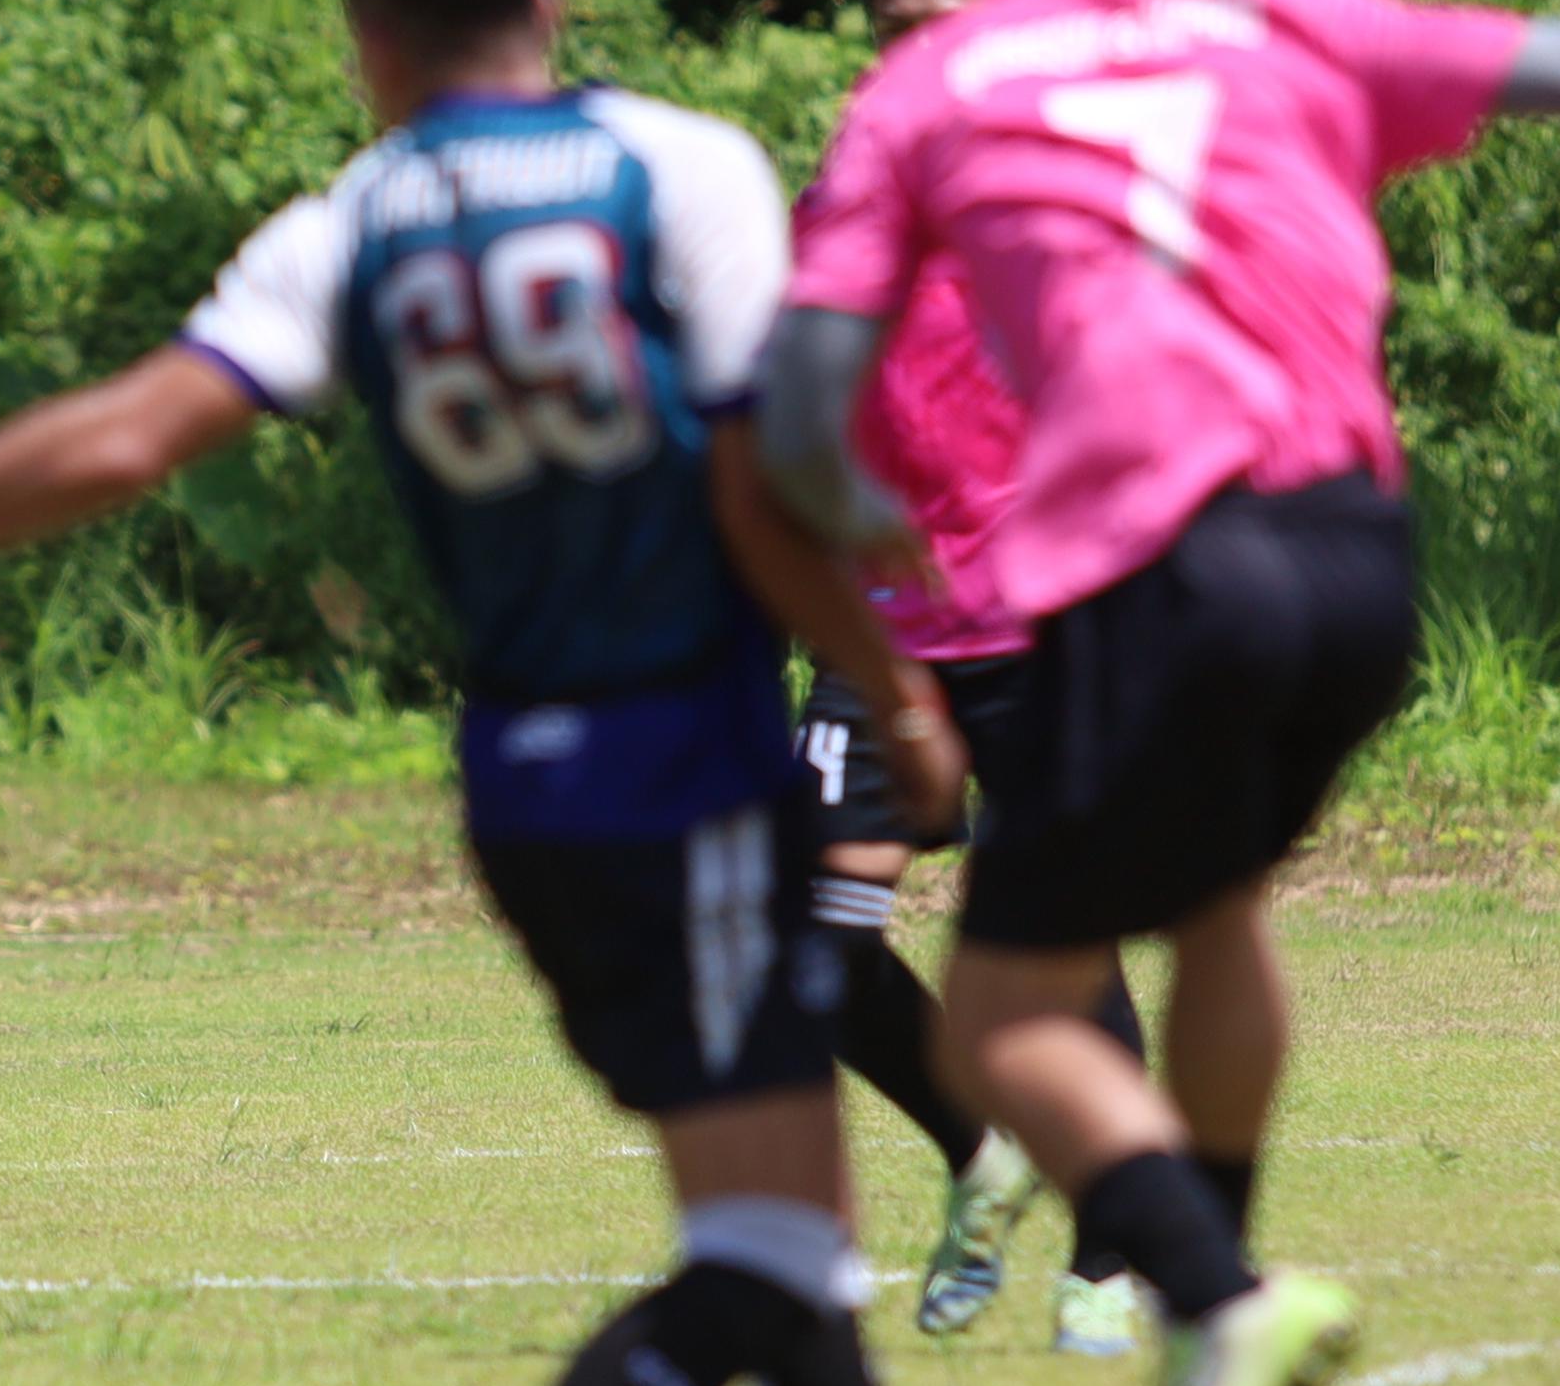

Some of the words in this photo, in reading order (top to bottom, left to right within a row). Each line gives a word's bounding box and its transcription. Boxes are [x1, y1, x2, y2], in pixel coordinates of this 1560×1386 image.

[1038, 69, 1222, 275] 7
[374, 220, 656, 499] 69
[793, 719, 850, 806] 4
